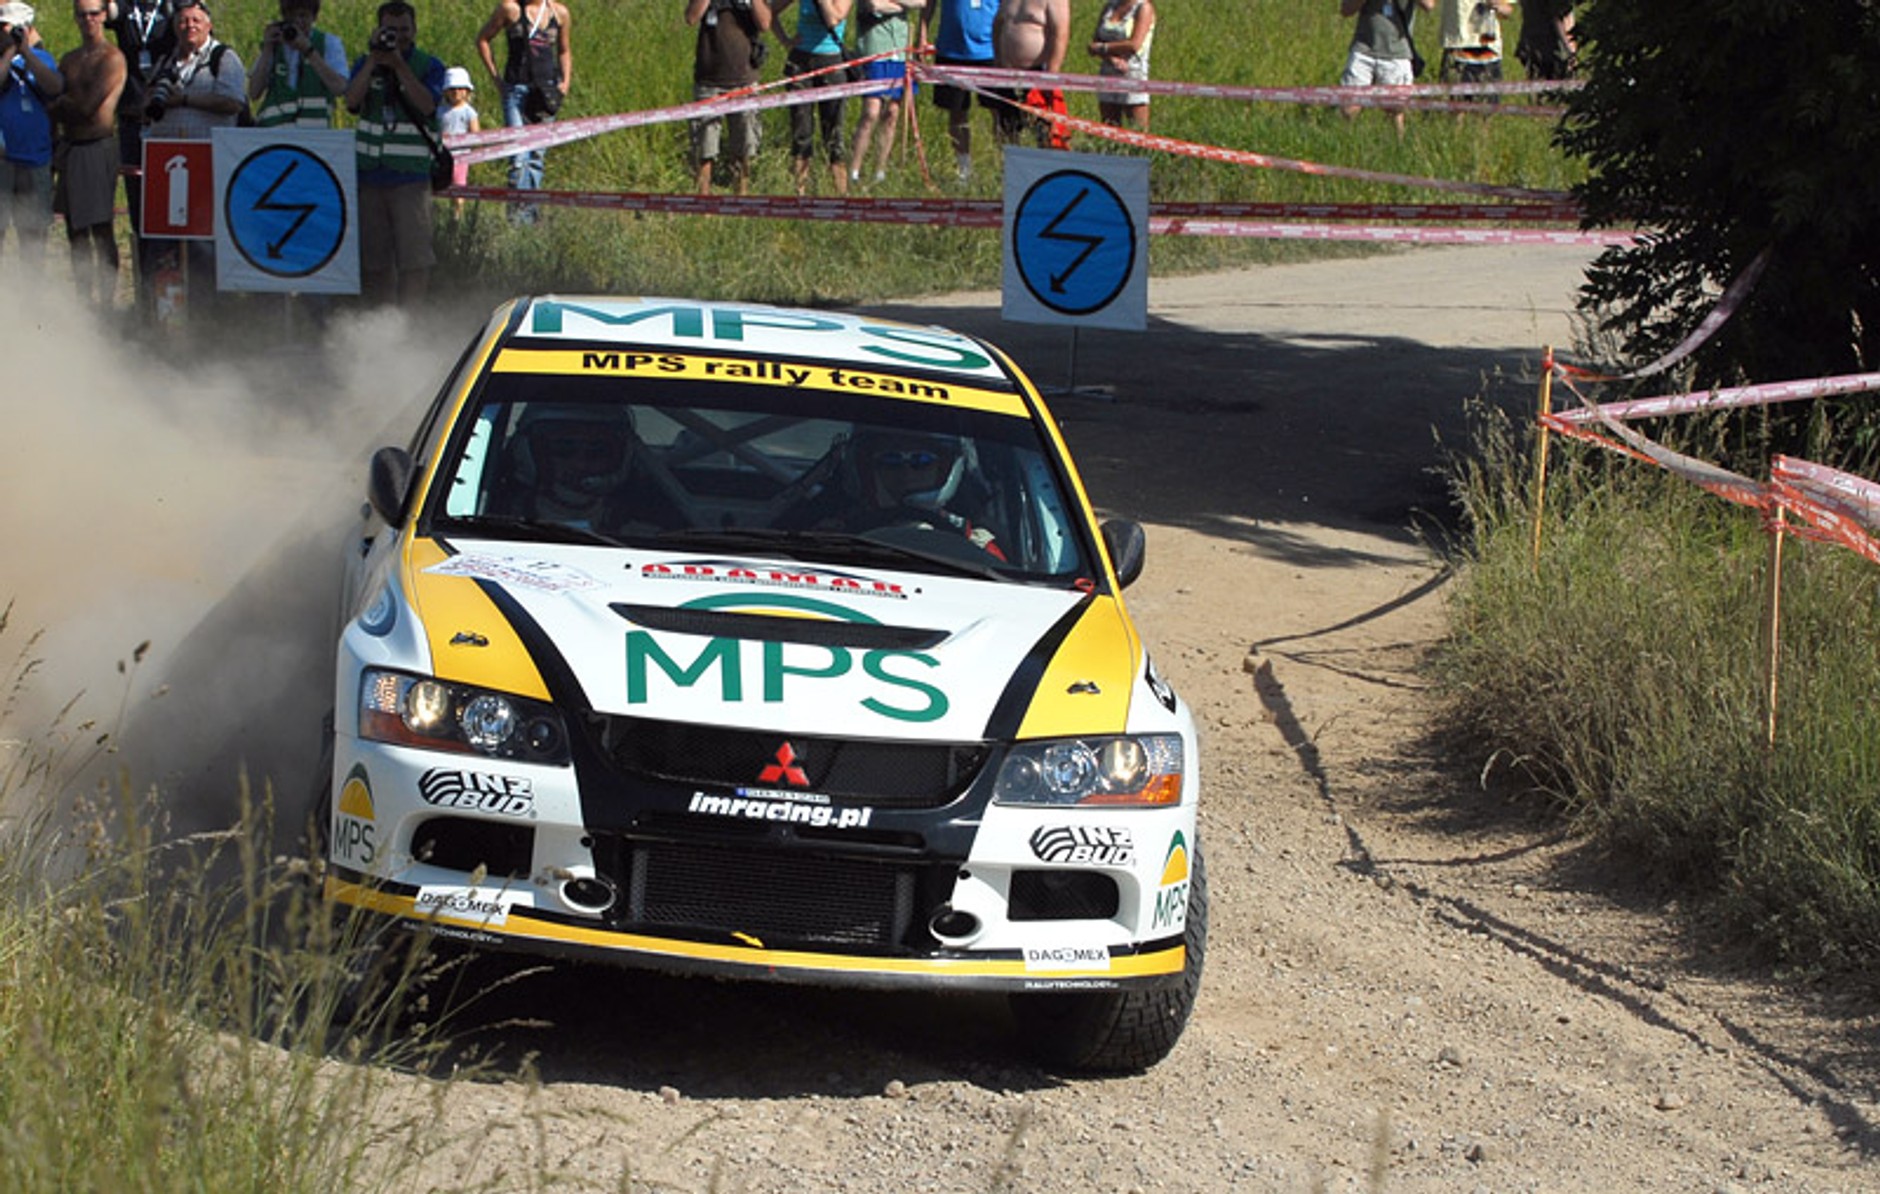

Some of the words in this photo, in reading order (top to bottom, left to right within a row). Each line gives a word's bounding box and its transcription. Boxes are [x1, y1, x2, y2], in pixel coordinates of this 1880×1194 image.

[532, 301, 991, 369] MPS
[582, 352, 687, 373] MPS
[705, 360, 813, 387] rally
[830, 369, 950, 400] team
[641, 564, 904, 593] ADAMAR
[625, 630, 951, 723] MPS
[453, 789, 534, 817] BUD
[688, 792, 872, 828] imracing.pl
[333, 815, 376, 864] MPS
[1068, 845, 1132, 865] BUD
[1152, 883, 1188, 929] MPS
[1028, 948, 1106, 962] DAGOMEX
